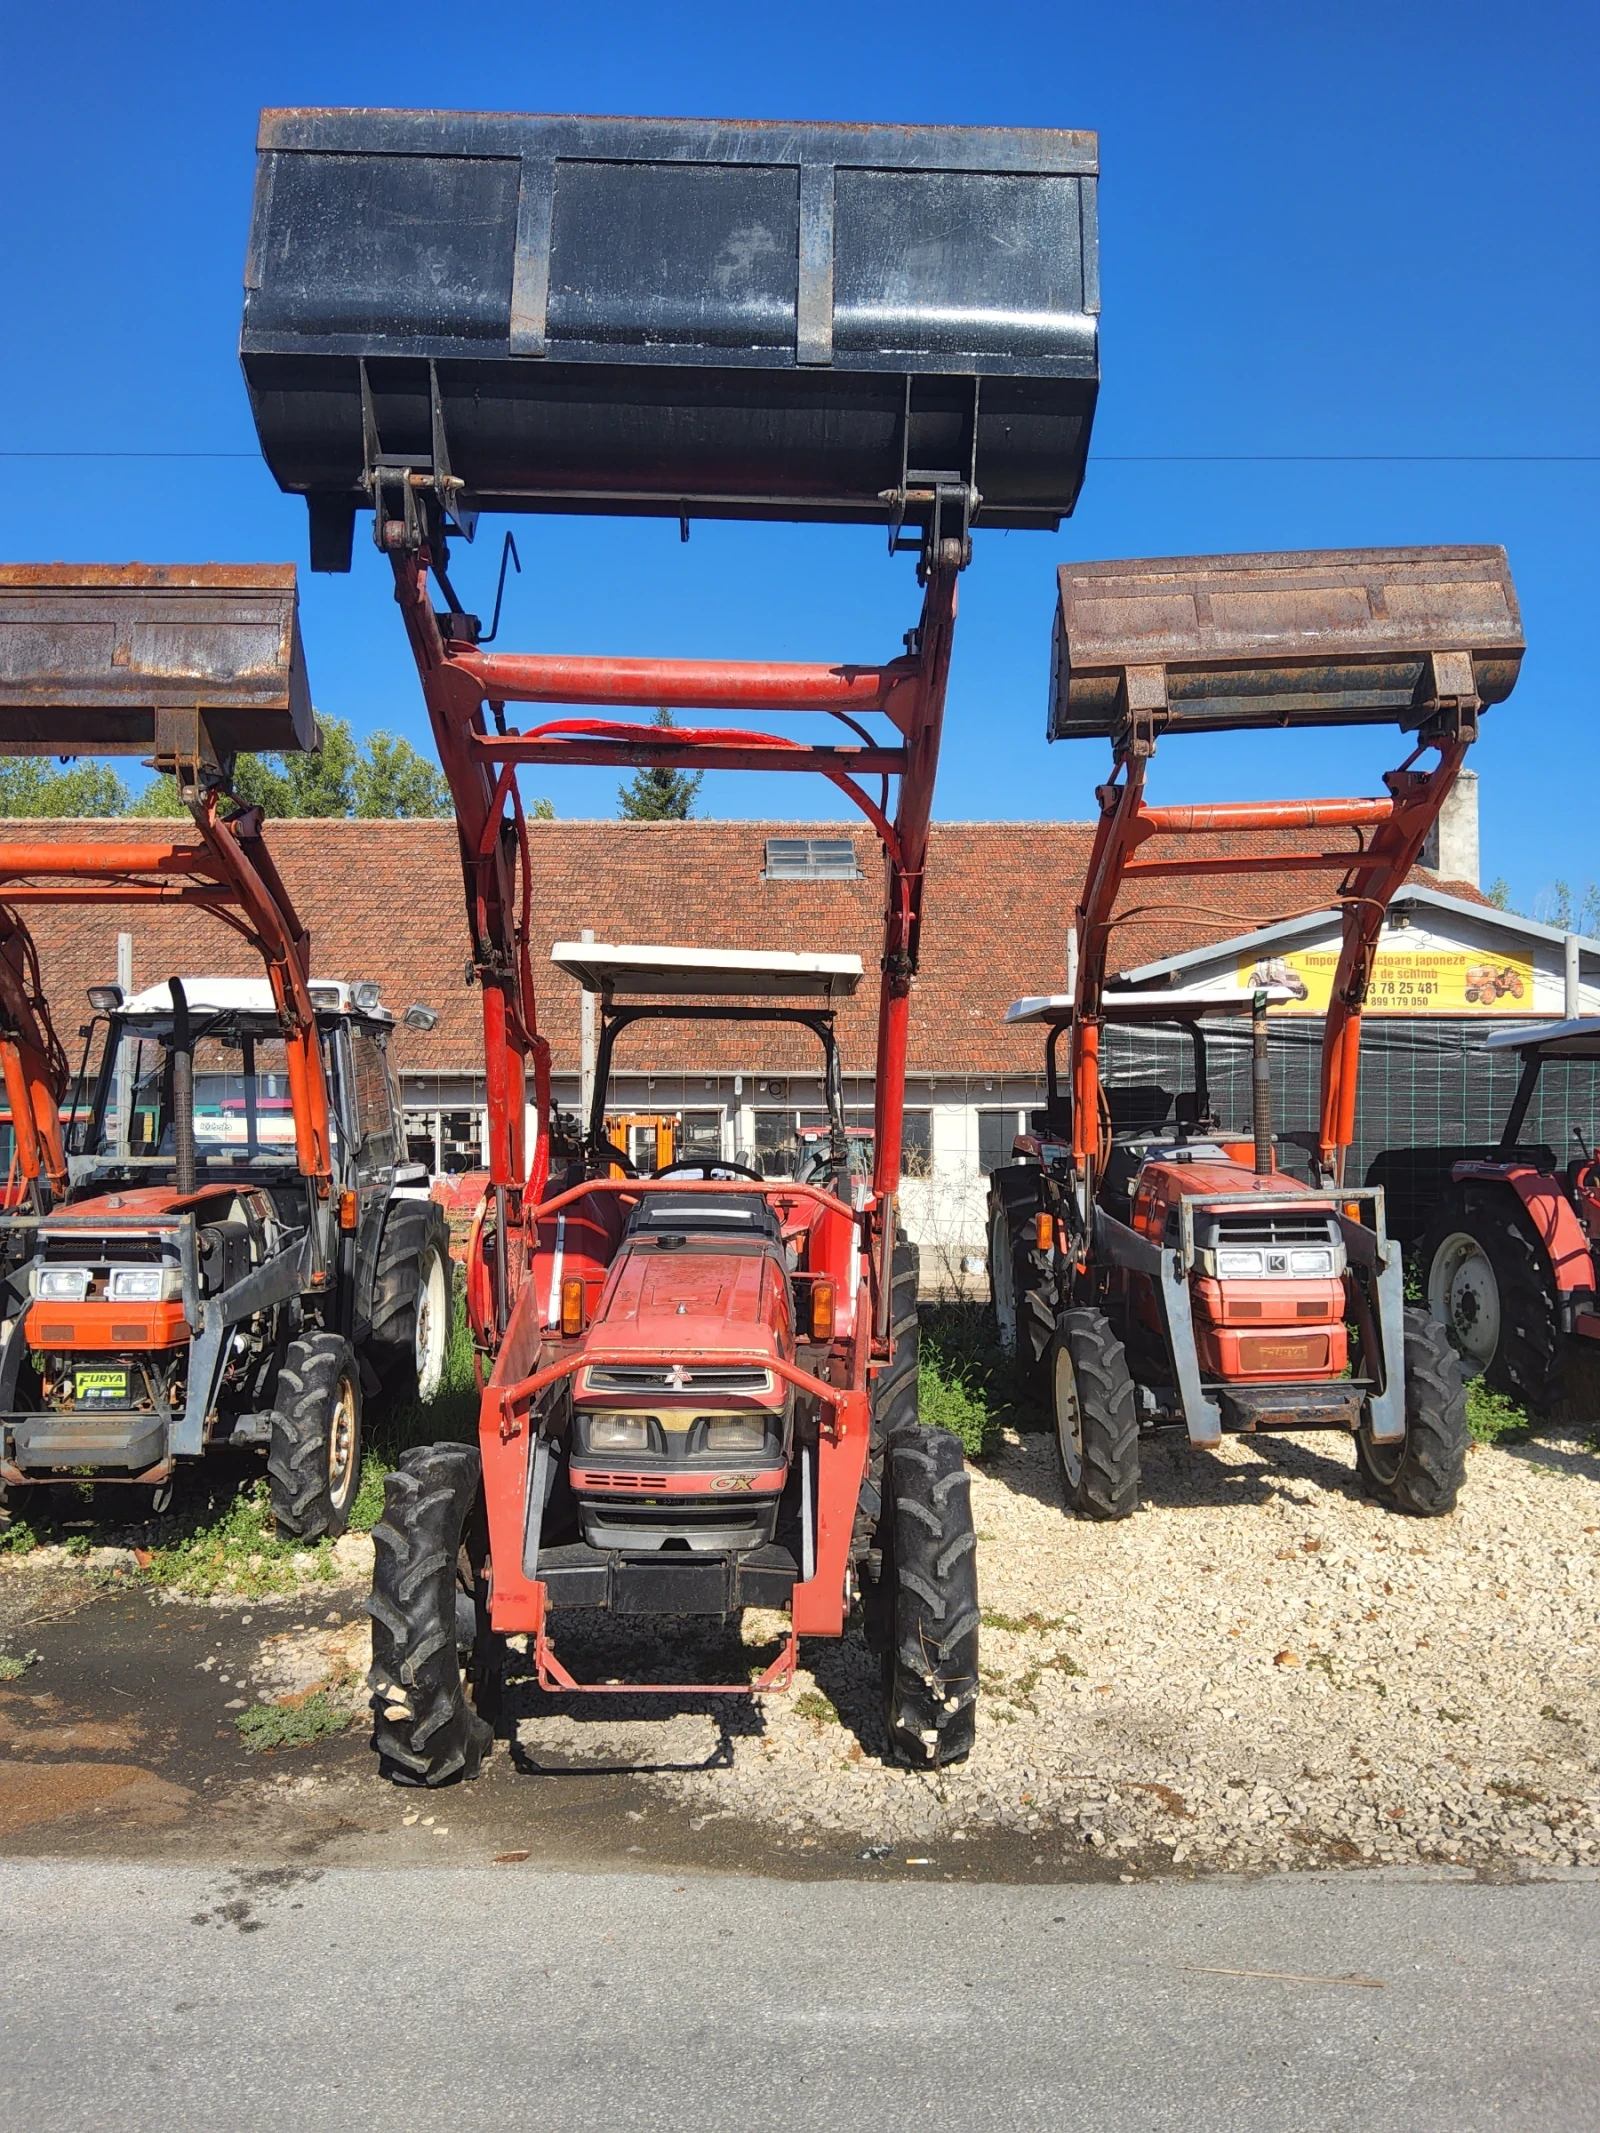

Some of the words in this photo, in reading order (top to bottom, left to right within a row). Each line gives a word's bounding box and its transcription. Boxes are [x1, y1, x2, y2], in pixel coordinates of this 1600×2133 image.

[1305, 954, 1339, 967] Impor
[1415, 954, 1466, 967] japoneze
[1381, 969, 1394, 979] de
[1397, 969, 1438, 979] schimb
[1380, 982, 1395, 994] 78
[1399, 982, 1414, 994] 25
[1418, 982, 1438, 994] 481
[1371, 997, 1388, 1006] 899
[1391, 997, 1408, 1006] 179
[1411, 997, 1428, 1006] 050
[1271, 1256, 1284, 1270] K
[79, 1375, 123, 1386] FURYA
